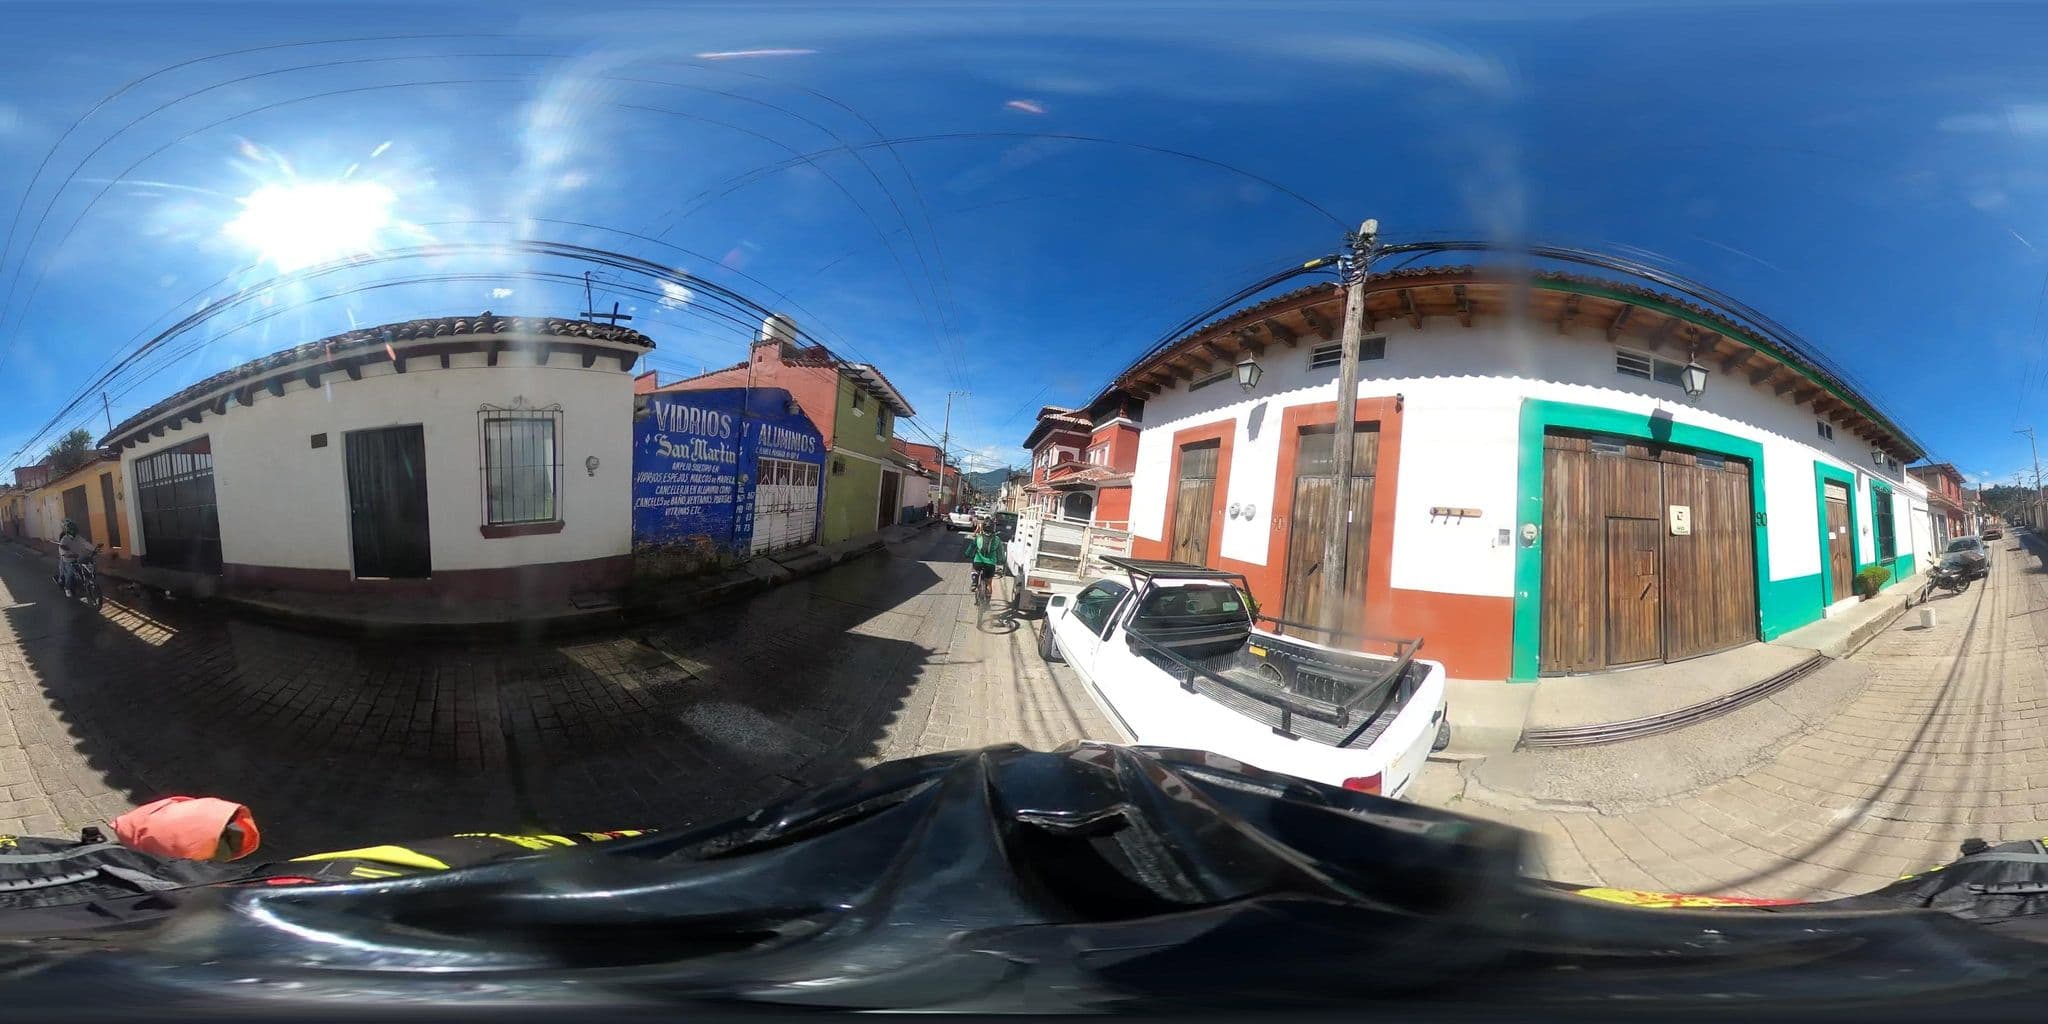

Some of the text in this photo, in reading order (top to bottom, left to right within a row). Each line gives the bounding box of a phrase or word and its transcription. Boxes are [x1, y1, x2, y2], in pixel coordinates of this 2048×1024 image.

[654, 433, 690, 459] San
[655, 400, 732, 439] VIDRIOS
[742, 421, 749, 438] Y
[758, 423, 816, 454] ALUMINIOS
